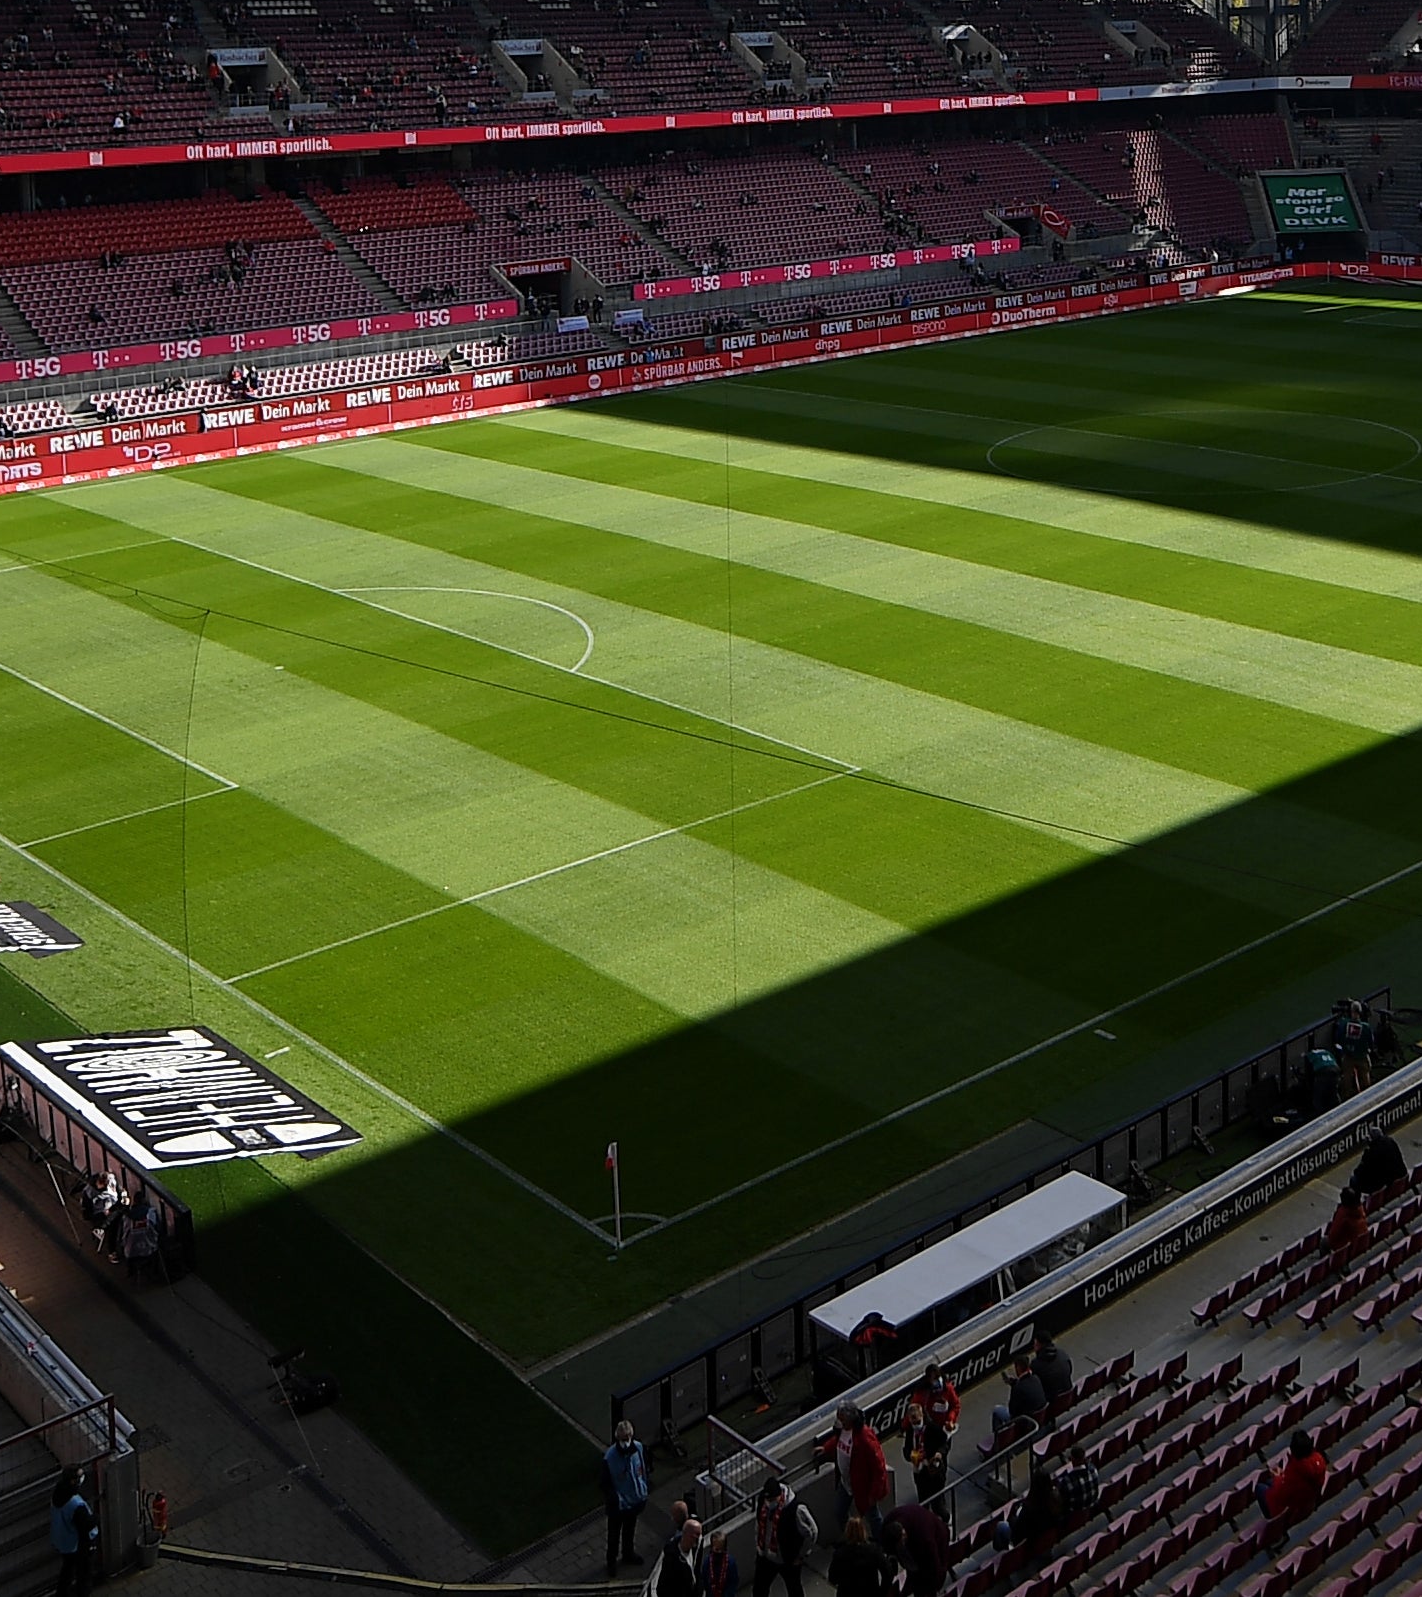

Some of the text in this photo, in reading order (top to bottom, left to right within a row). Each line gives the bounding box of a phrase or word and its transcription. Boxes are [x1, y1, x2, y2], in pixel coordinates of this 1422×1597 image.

[767, 109, 794, 121] IMMER
[486, 121, 606, 139] Oft hart, IMMER sportlich.
[187, 137, 332, 159] Oft hart, IMMER sportlich.
[1288, 189, 1326, 197] Mer
[1294, 205, 1331, 214] Dir!
[1284, 216, 1347, 225] DEVK
[1212, 263, 1234, 275] REWE
[1071, 278, 1137, 297] REWE Dein Markt
[996, 289, 1065, 308] REWE Dein Markt
[429, 311, 450, 326] 5G
[911, 301, 985, 321] REWE Dein Markt
[1002, 307, 1056, 323] DuoTherm
[308, 323, 330, 342] 5G
[821, 314, 902, 335] REWE Dein Markt
[722, 327, 809, 350] REWE Dein Markt
[815, 339, 840, 351] dhpg
[177, 339, 201, 358] 5G
[34, 357, 60, 377] 5G
[587, 353, 624, 371] REWE
[644, 363, 683, 380] SPÜRBAR
[687, 357, 723, 376] ANDERS.
[472, 362, 577, 388] REWE Dein Markt
[347, 379, 460, 408] REWE Dein Markt
[205, 397, 330, 428] REWE Dein Markt
[49, 419, 186, 453] REWE Dein Markt
[1084, 1239, 1181, 1308] Hochwertige
[1185, 1135, 1354, 1251] Kaffee-Komplettlösungen
[1376, 1091, 1422, 1134] Firmen!
[947, 1344, 1005, 1387] artner
